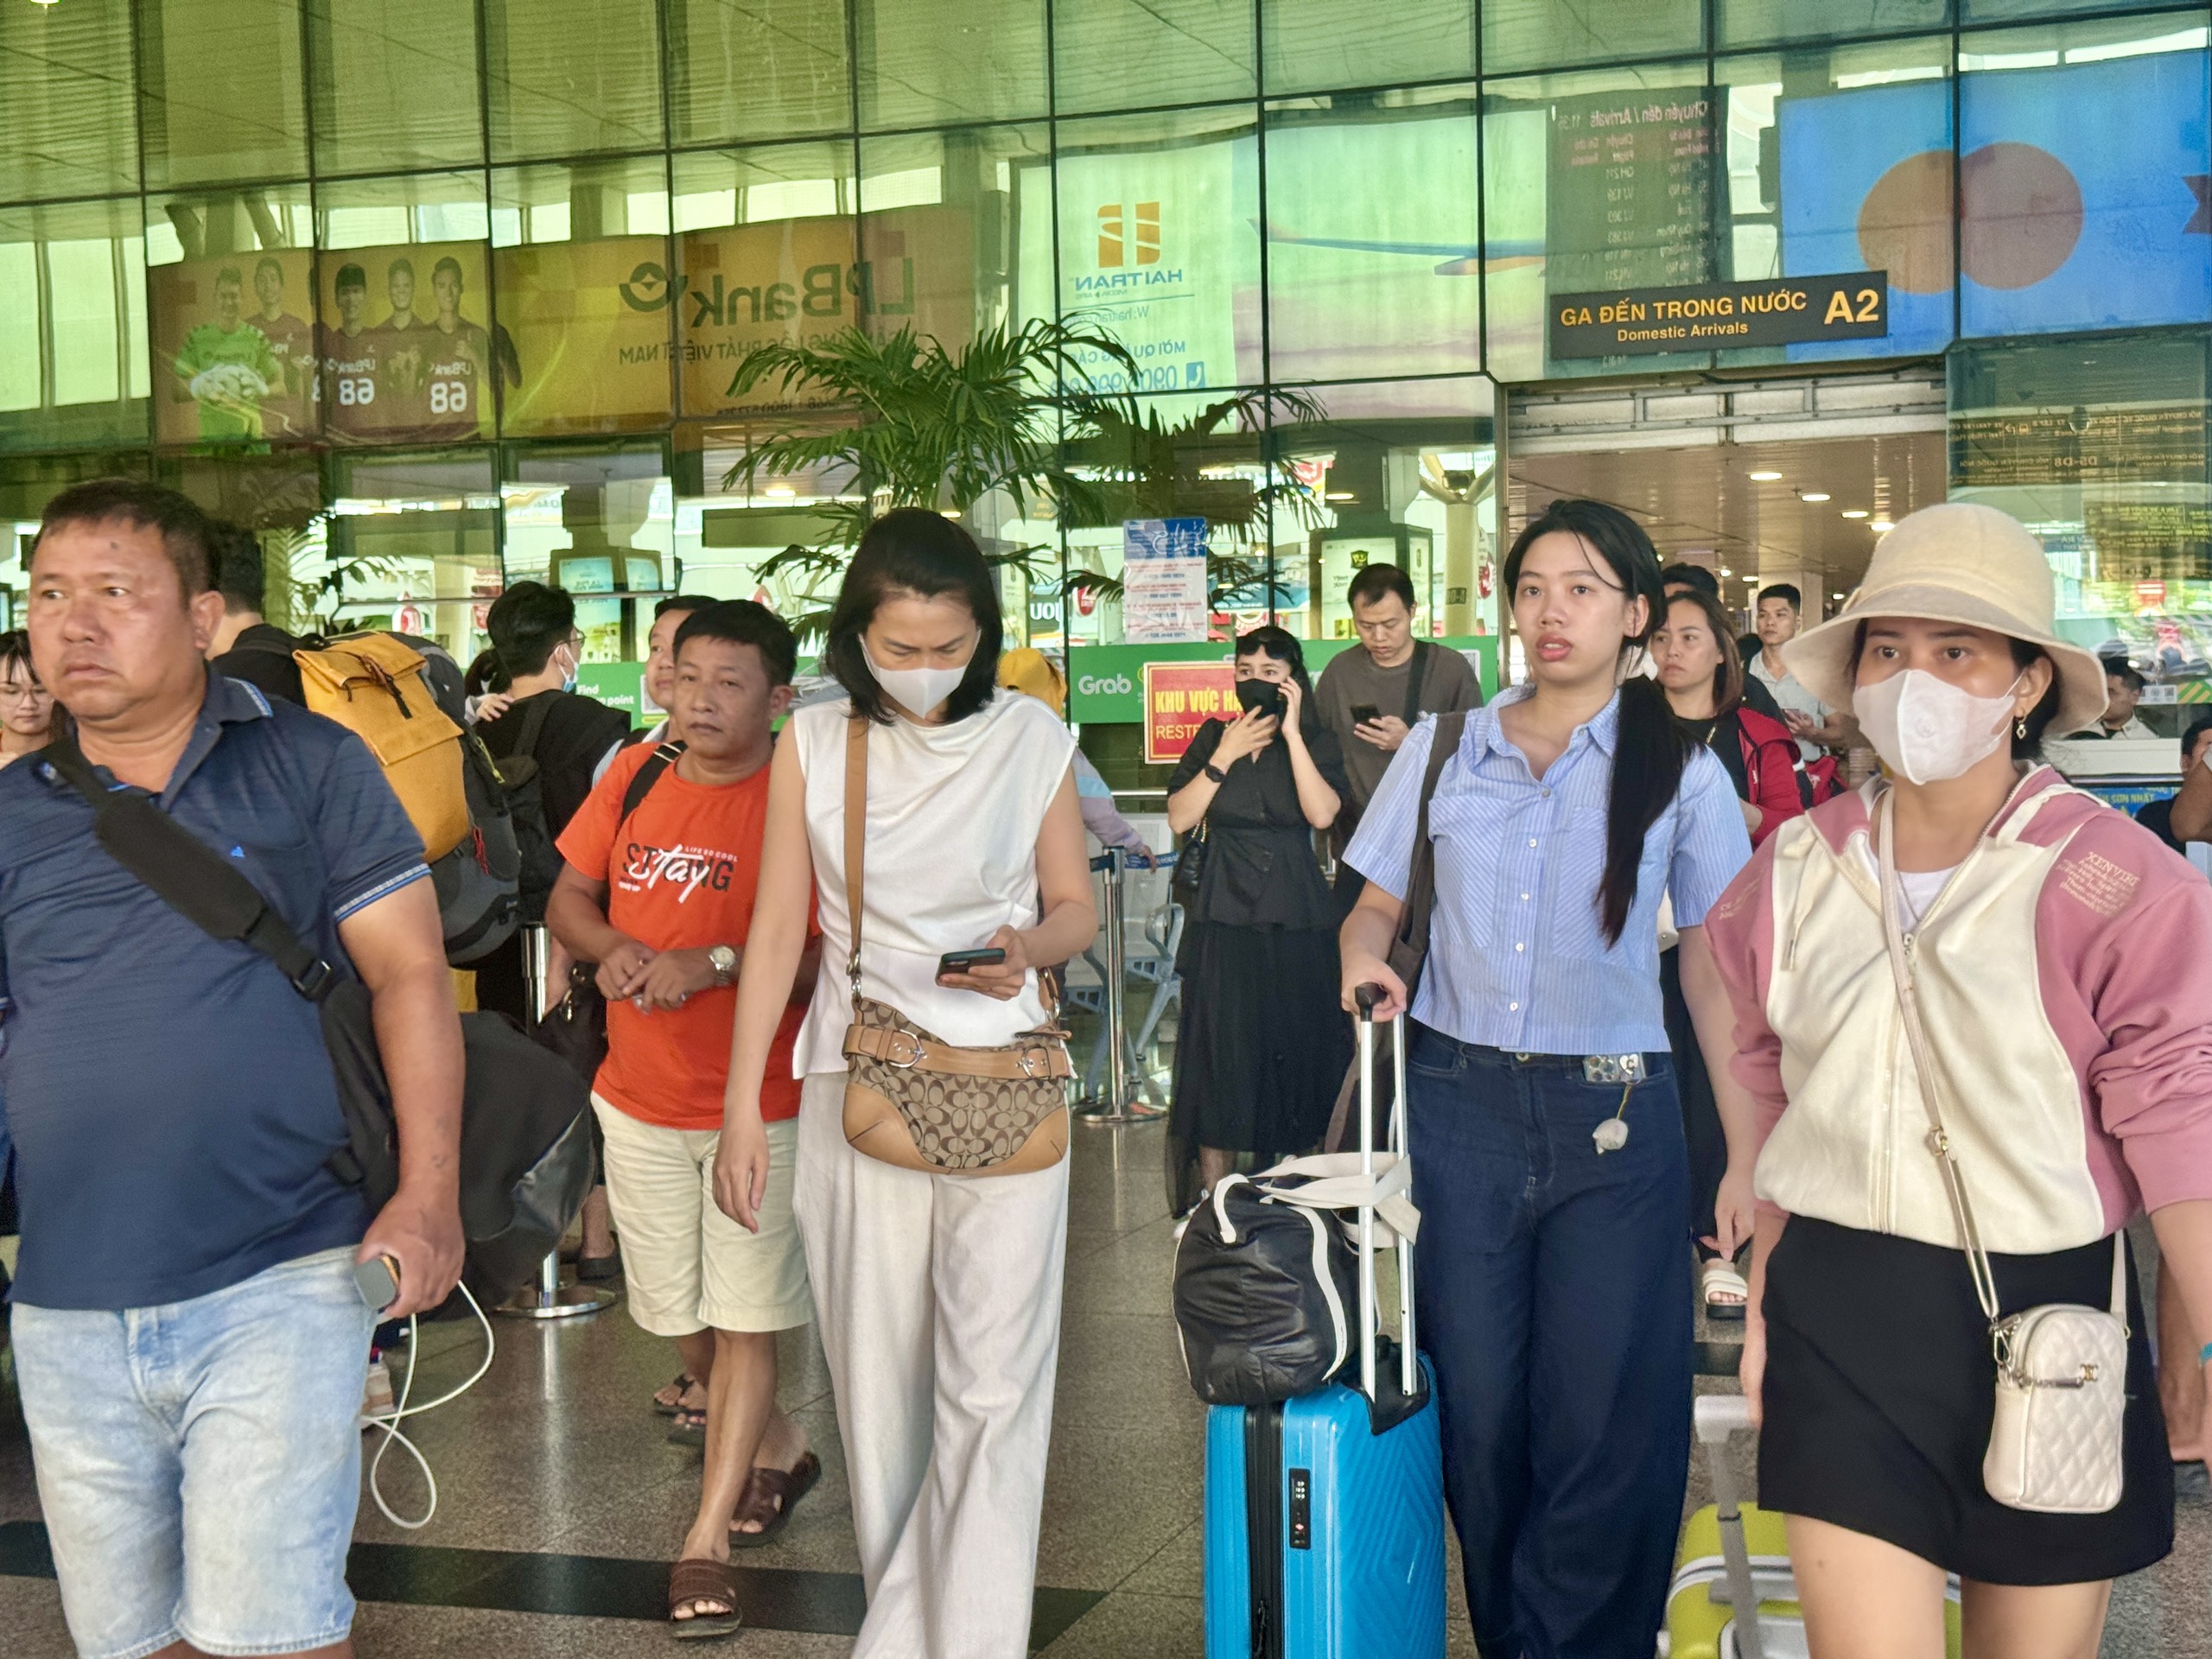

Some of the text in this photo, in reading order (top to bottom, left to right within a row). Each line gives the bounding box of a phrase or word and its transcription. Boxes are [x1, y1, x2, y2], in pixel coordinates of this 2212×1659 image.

[1560, 288, 1808, 327] GA ĐẾN TRONG NƯỚC
[1823, 289, 1880, 326] A2
[1617, 321, 1750, 343] Domestic Arrivals
[575, 683, 600, 696] Find
[1077, 672, 1133, 696] Grab
[607, 695, 635, 708] point
[1154, 690, 1186, 715] KHU
[1188, 686, 1220, 717] VỰC
[715, 850, 739, 863] COOL
